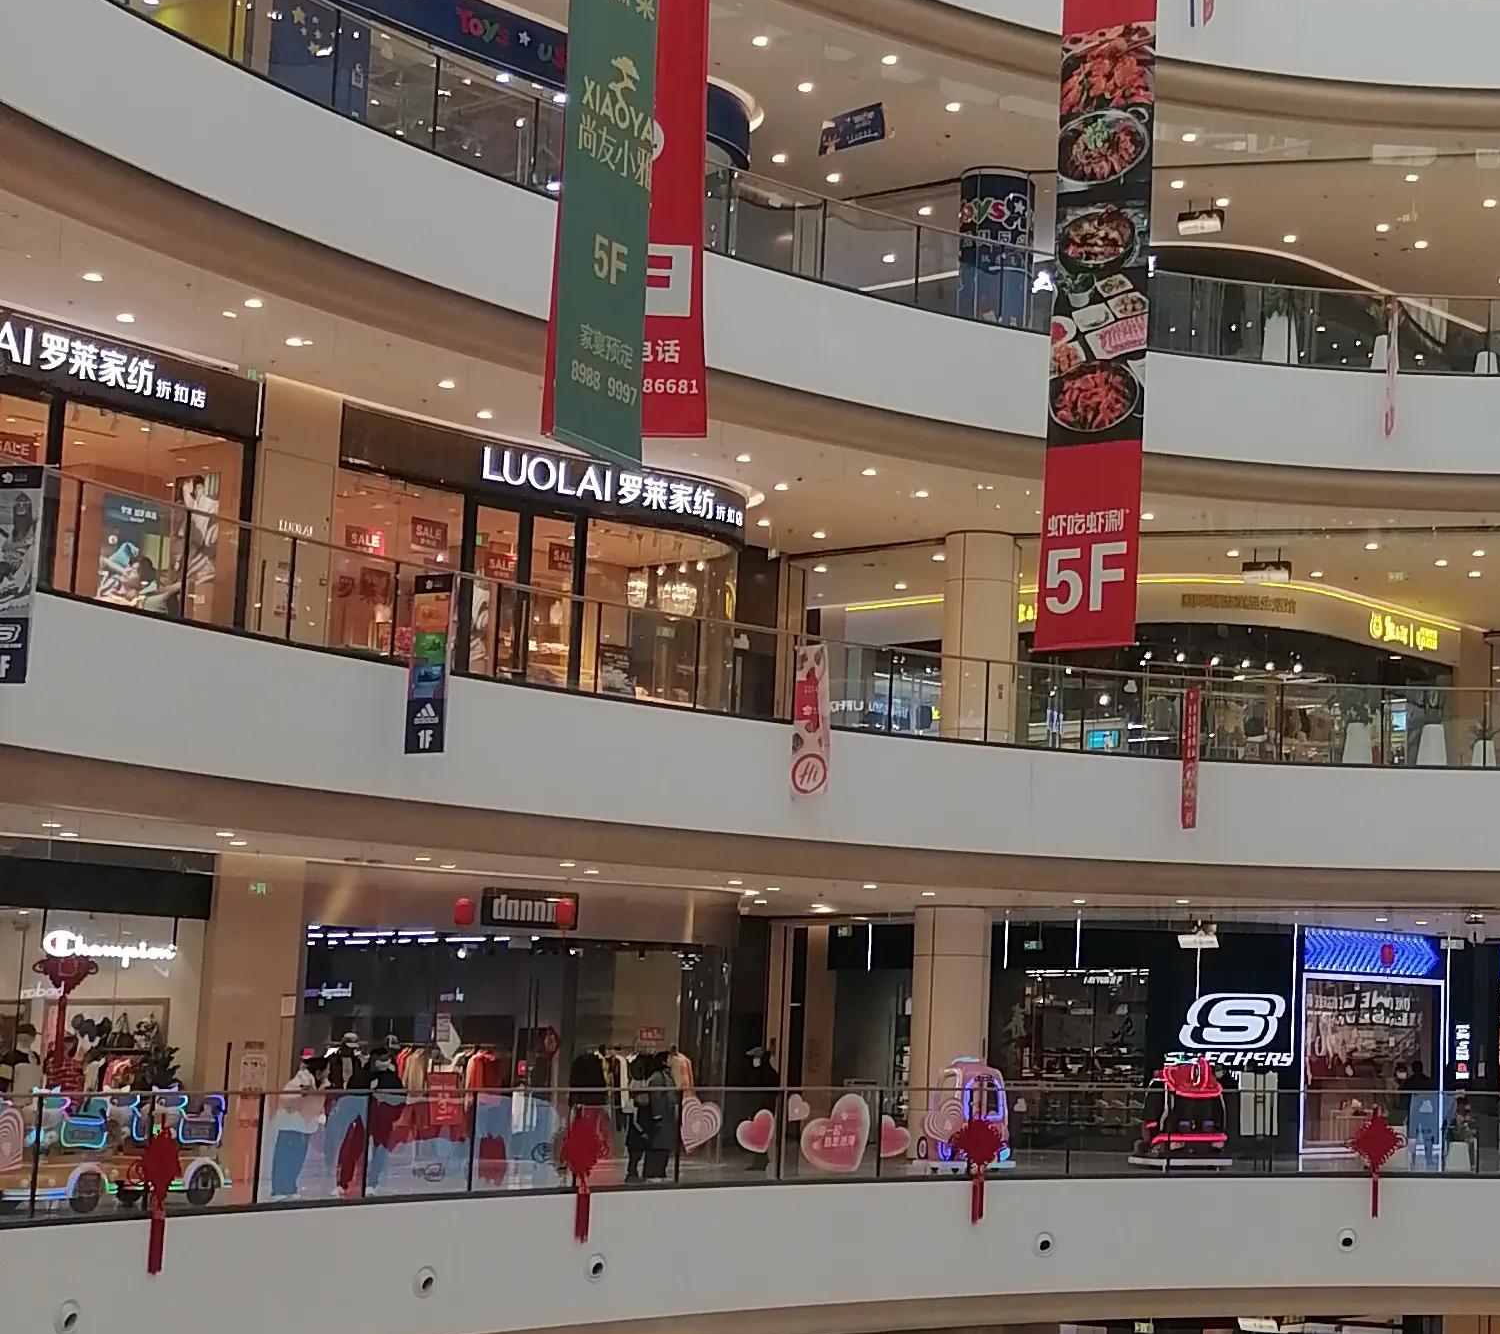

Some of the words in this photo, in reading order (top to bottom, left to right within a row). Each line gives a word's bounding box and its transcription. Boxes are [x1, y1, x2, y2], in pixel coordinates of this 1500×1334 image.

[581, 74, 654, 142] XIAOYA
[592, 232, 629, 285] 5F
[40, 331, 156, 396] 罗莱家纺
[155, 377, 208, 409] 折扣店
[482, 445, 613, 502] LUOLAI
[616, 472, 716, 520] 罗莱家纺
[350, 532, 381, 549] SALE
[415, 522, 443, 542] SALE
[1046, 508, 1125, 538] 虾吃虾涮
[489, 558, 515, 573] SALE
[1044, 540, 1129, 615] 5F
[417, 728, 434, 750] 1F
[42, 929, 177, 967] Champion
